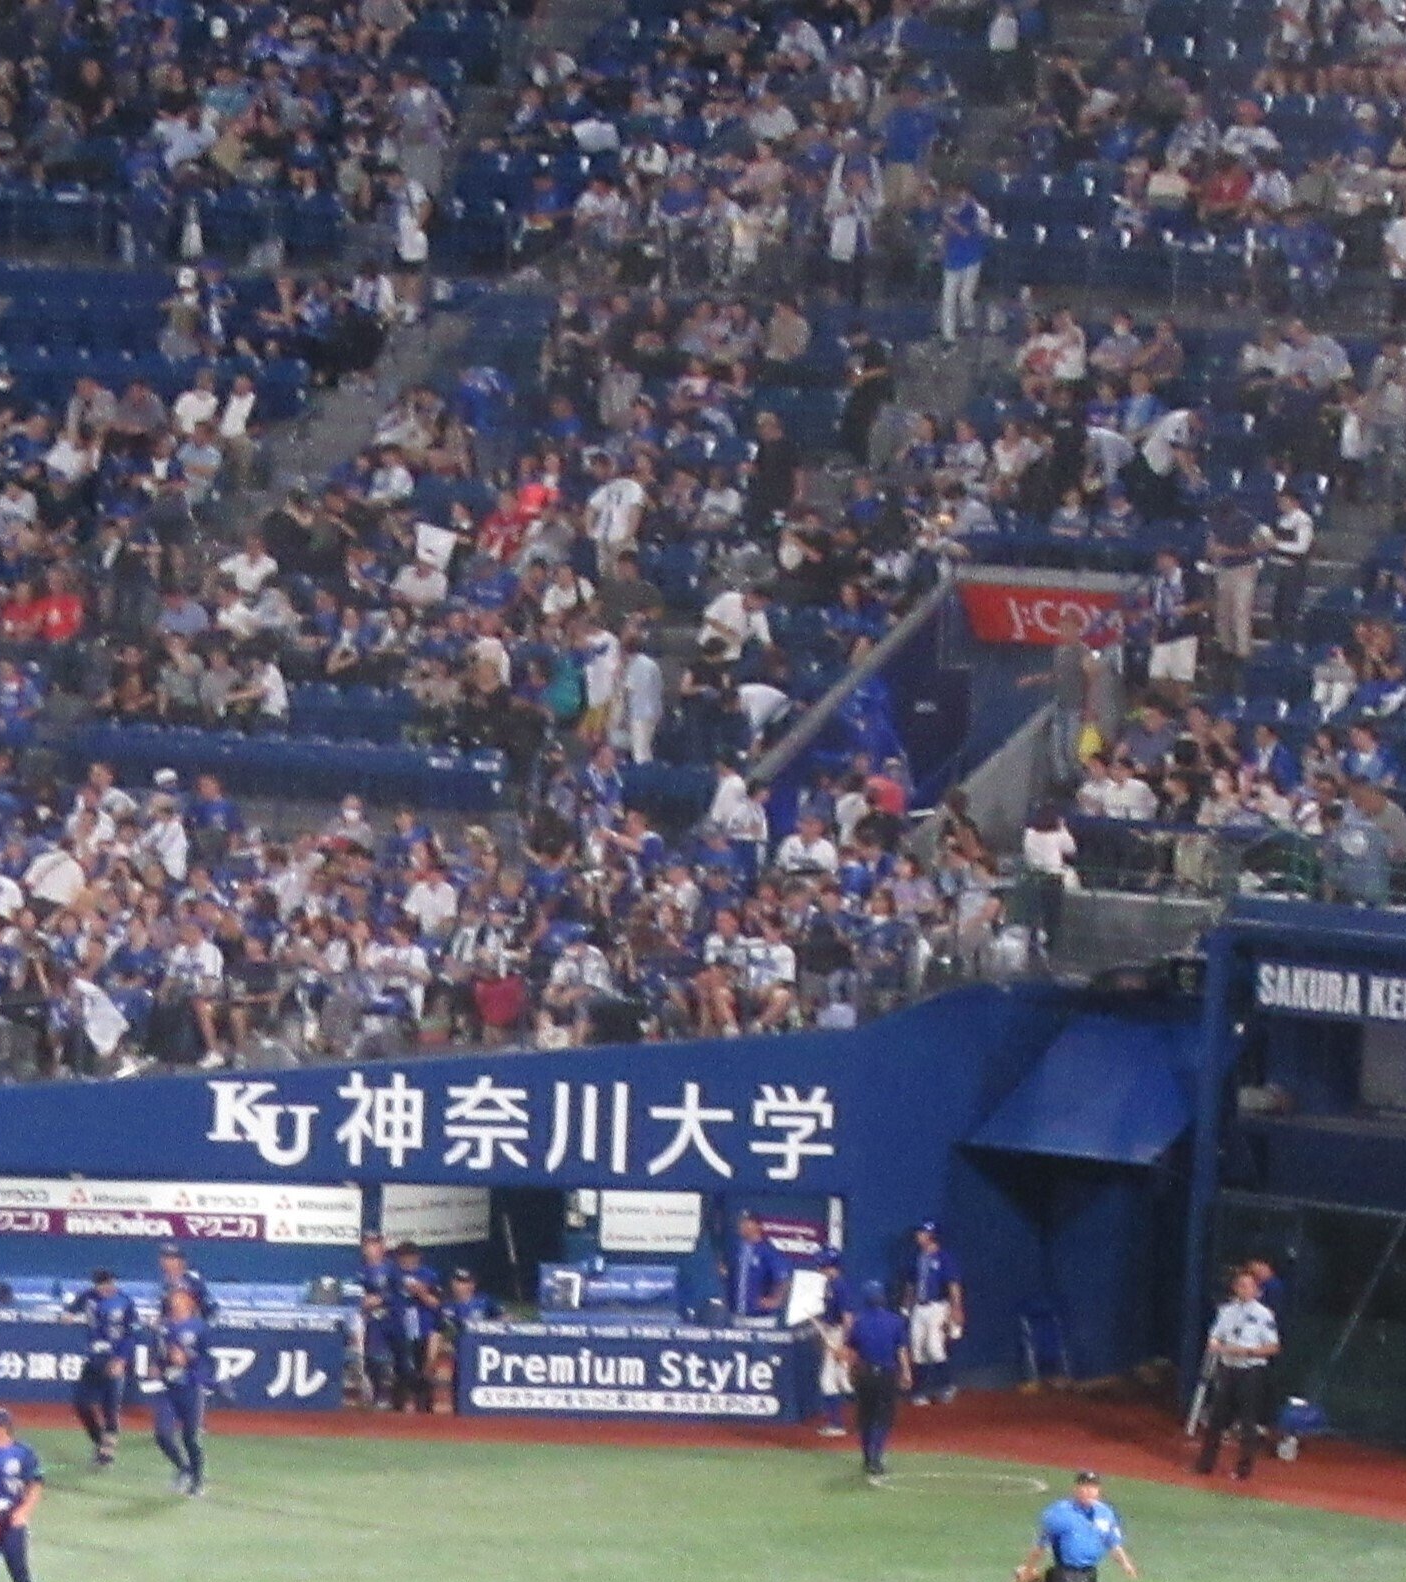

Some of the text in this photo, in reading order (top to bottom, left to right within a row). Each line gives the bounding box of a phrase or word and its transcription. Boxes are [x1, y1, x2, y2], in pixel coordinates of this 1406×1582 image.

[1257, 963, 1362, 1016] SAKURA
[336, 1072, 835, 1180] 神奈川大学
[478, 1345, 775, 1393] Premium Style
